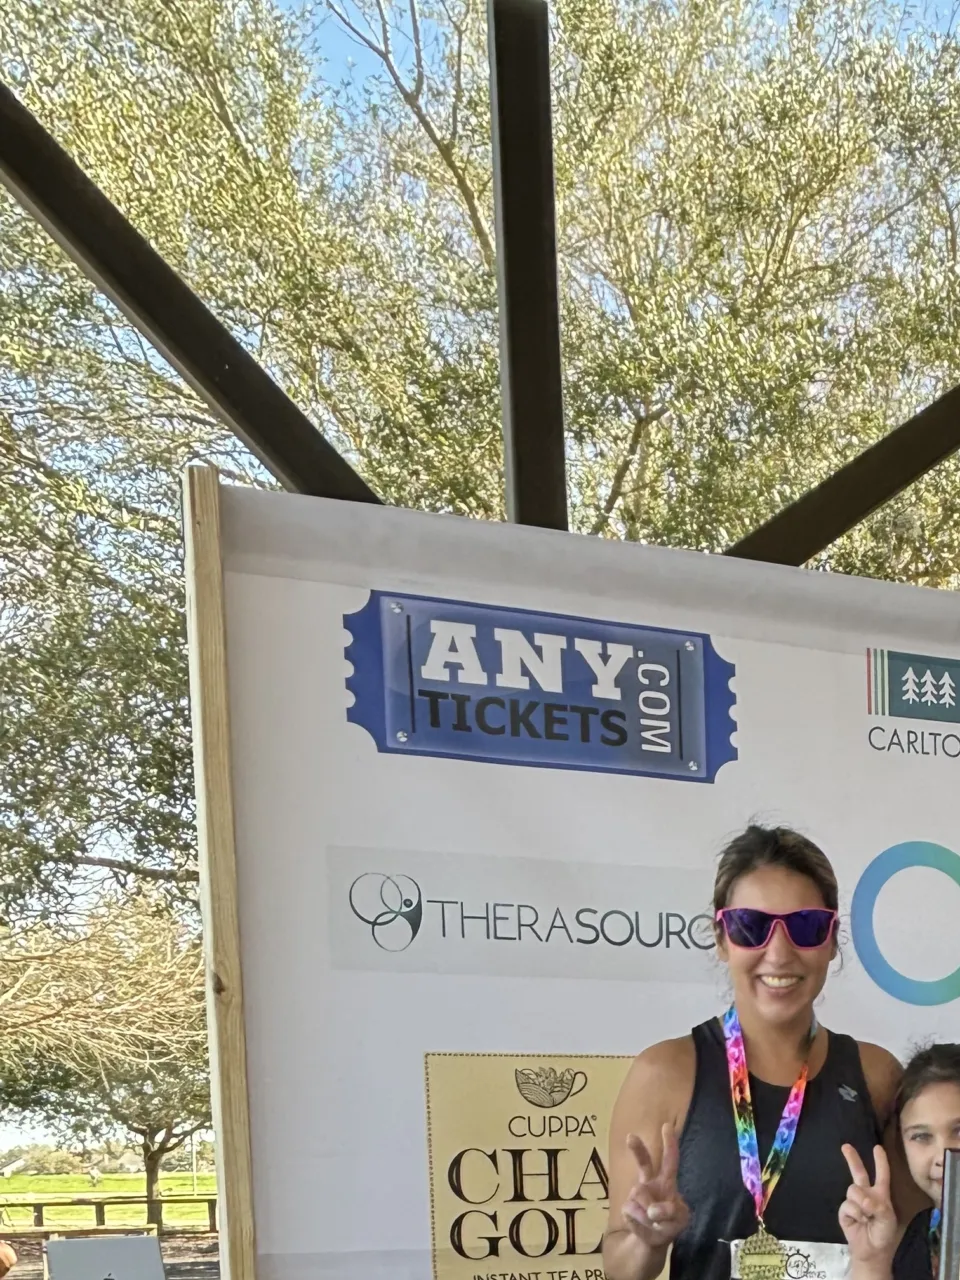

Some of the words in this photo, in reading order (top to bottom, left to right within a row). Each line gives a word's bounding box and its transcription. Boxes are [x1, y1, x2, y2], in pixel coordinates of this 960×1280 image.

[421, 620, 633, 700] ANY
[418, 690, 628, 747] TICKETS
[426, 899, 716, 950] THERASOURC
[447, 1147, 609, 1205] CHA
[450, 1207, 609, 1260] GOL
